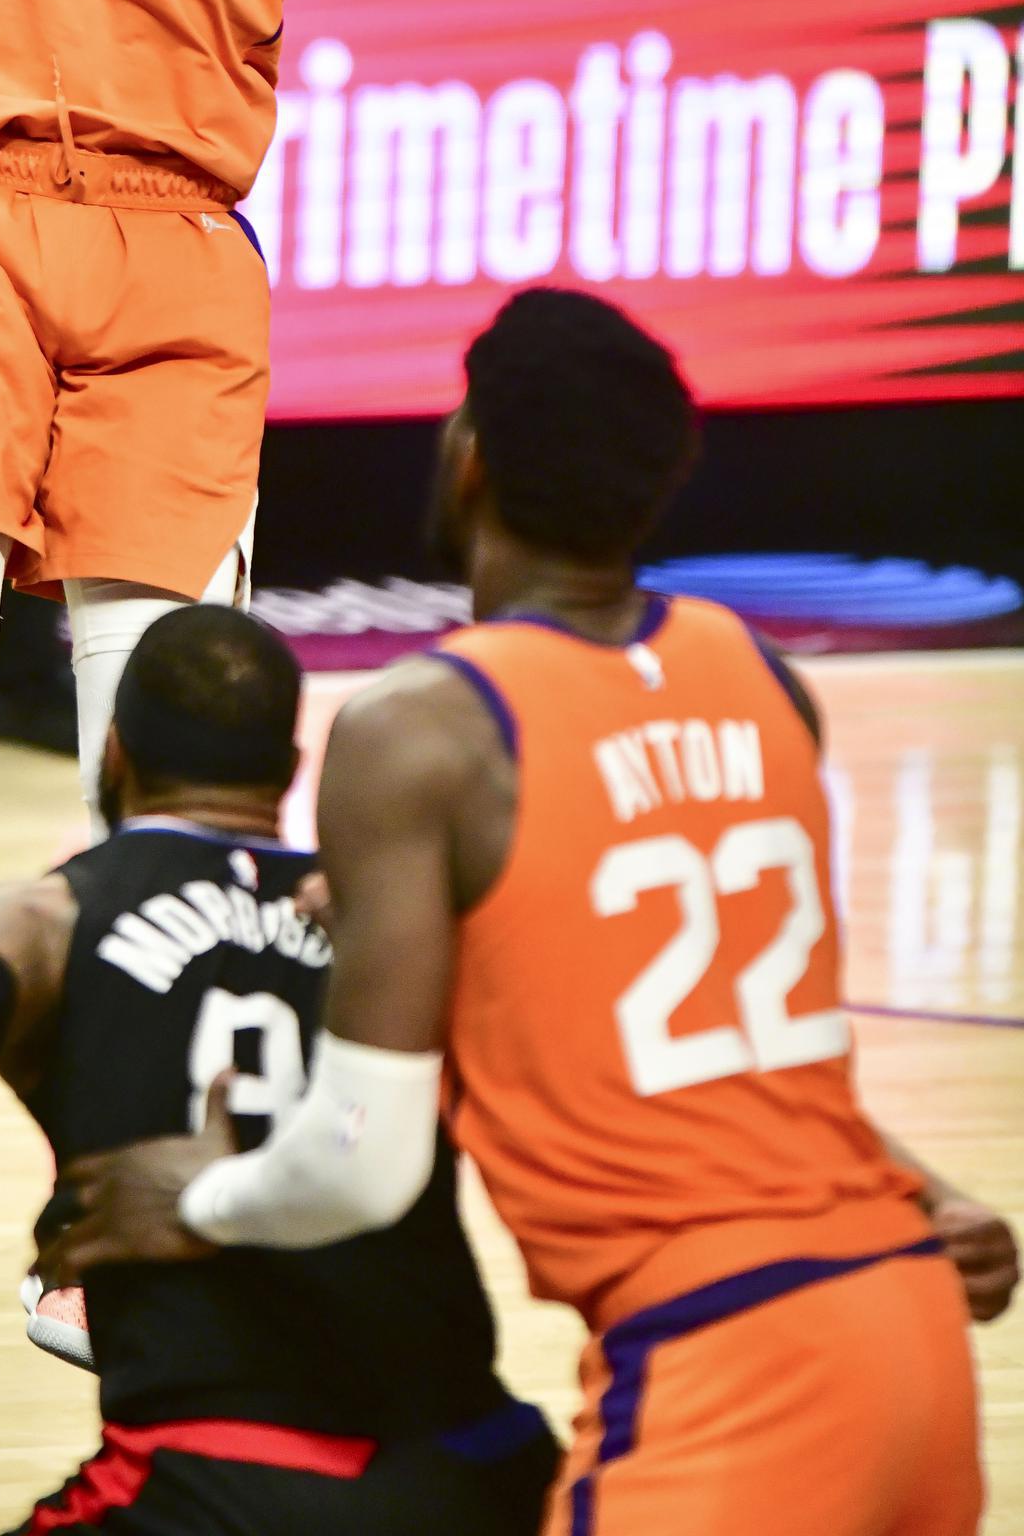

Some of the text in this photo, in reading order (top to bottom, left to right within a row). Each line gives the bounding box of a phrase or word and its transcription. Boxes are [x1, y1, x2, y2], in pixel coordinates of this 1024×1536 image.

[238, 16, 1024, 290] rimetime P
[590, 816, 853, 1097] 22
